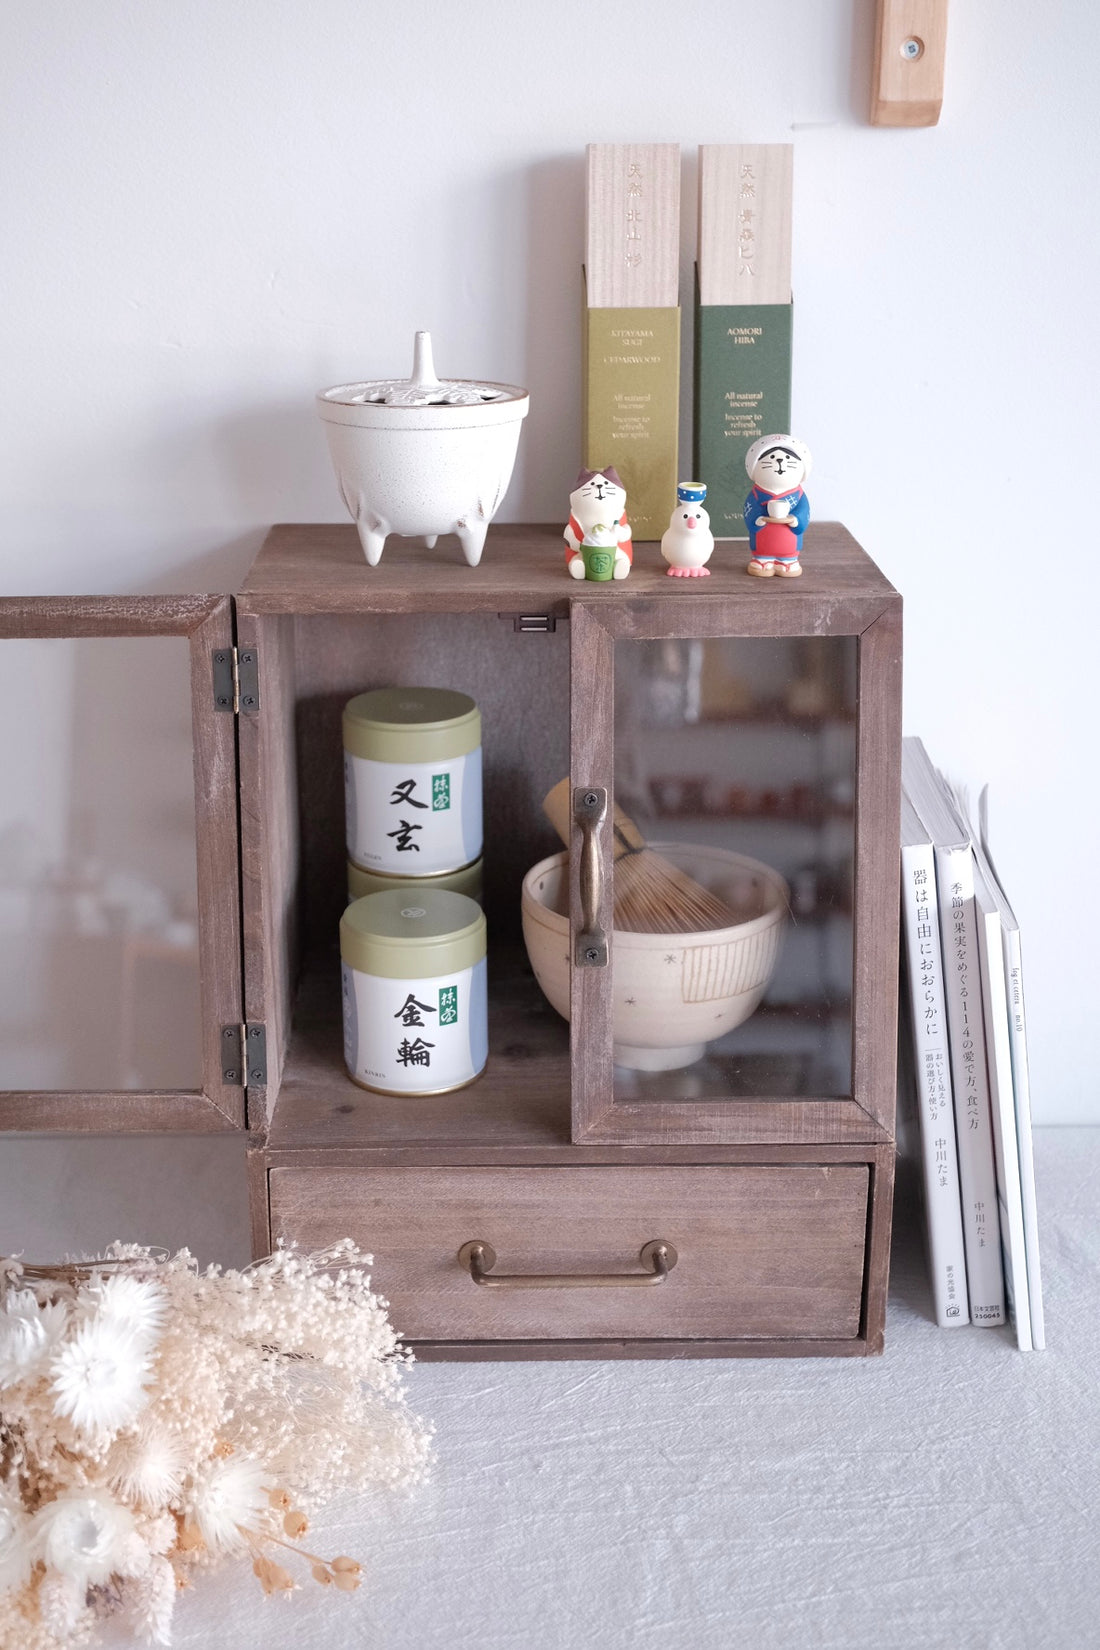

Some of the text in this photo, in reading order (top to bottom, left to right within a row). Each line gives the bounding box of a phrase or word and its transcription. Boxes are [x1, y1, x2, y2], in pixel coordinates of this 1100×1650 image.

[725, 391, 763, 400] All natural
[386, 778, 429, 852] 又玄
[913, 869, 938, 1035] 器は自由におおらかに
[394, 993, 437, 1067] 金輪
[951, 882, 979, 1130] 季節の果実をめぐる114の愛で方、食べ方
[935, 1053, 946, 1107] おいしく見える
[935, 1137, 948, 1187] 中川たま
[974, 1201, 986, 1247] 中川たま
